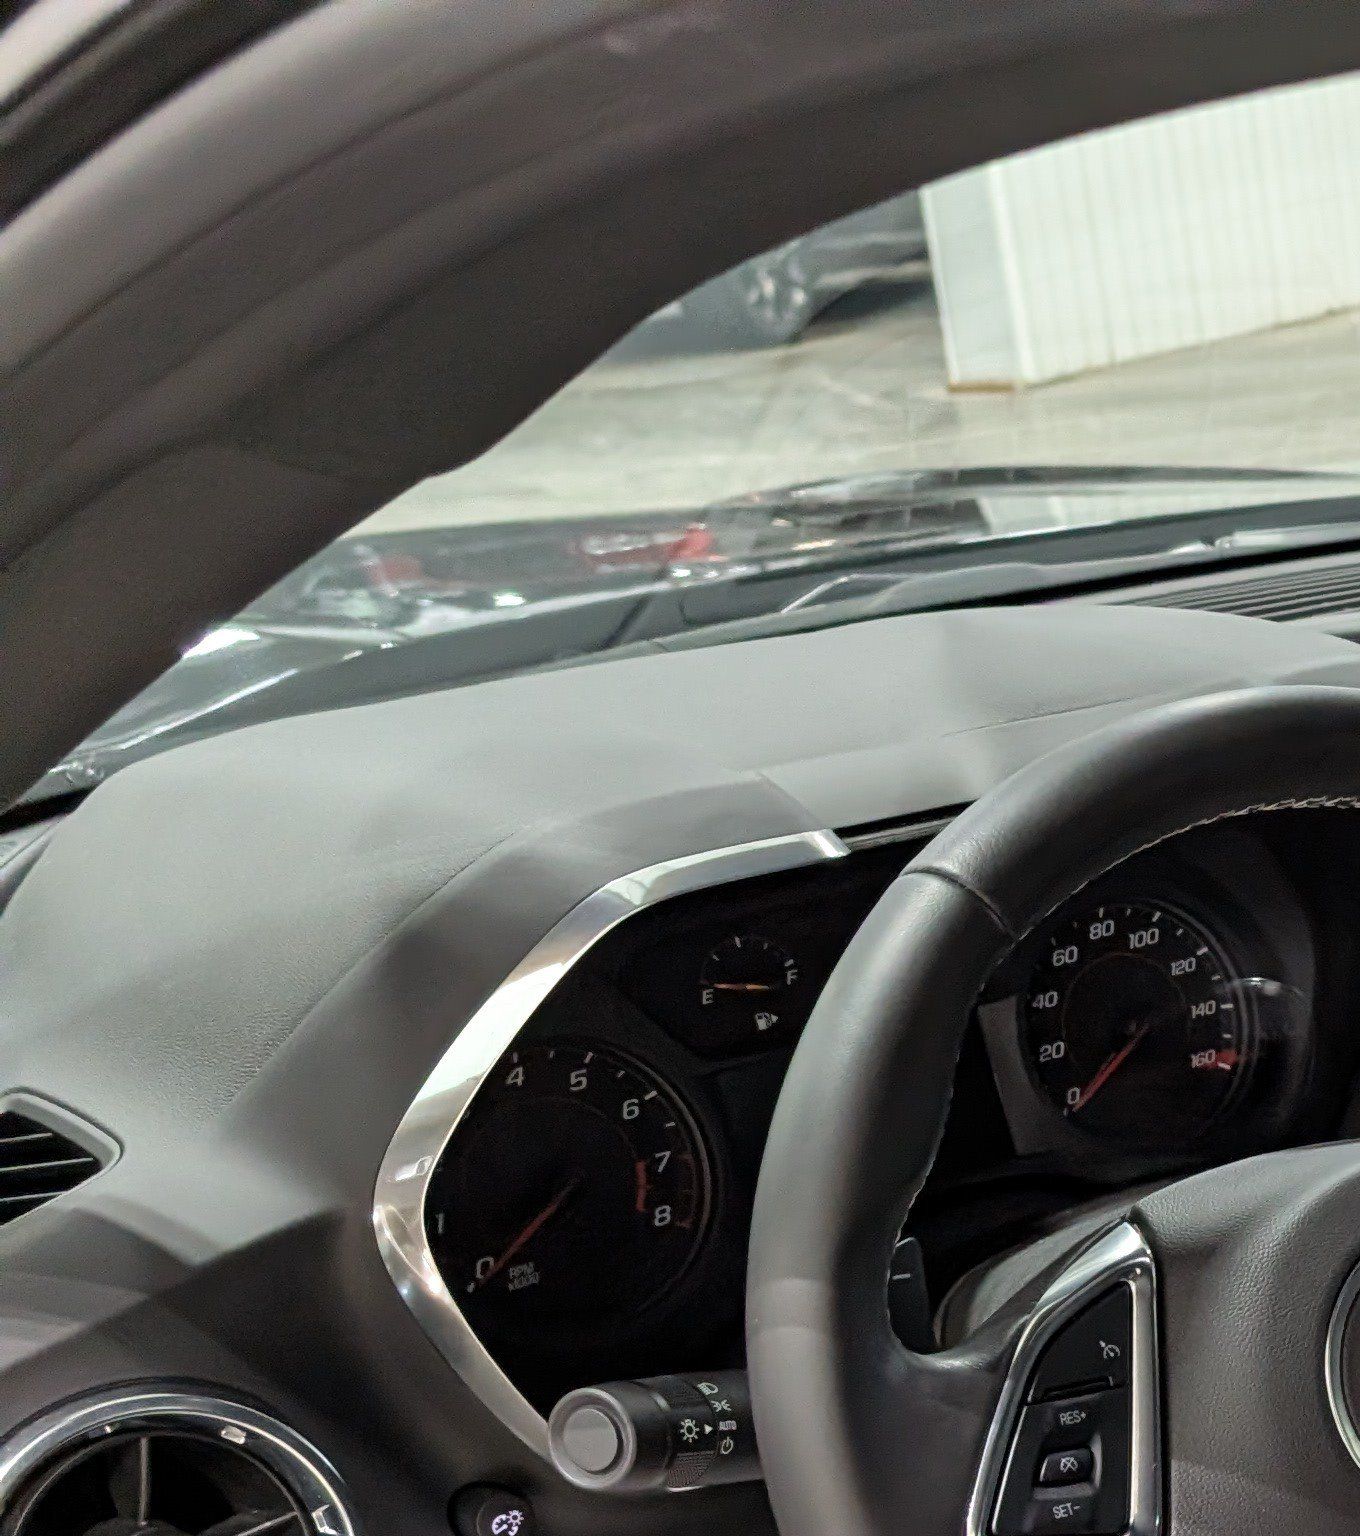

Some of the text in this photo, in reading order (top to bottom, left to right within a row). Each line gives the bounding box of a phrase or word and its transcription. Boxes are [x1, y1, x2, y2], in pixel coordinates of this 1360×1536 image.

[1089, 920, 1115, 940] 80
[1128, 928, 1160, 949] 100
[1052, 945, 1079, 967] 60
[1170, 957, 1196, 976] 120
[785, 969, 798, 985] F
[702, 989, 714, 1005] E
[1032, 991, 1059, 1010] 40
[1191, 1000, 1217, 1019] 140
[1039, 1041, 1065, 1062] 20
[1191, 1049, 1217, 1069] 160
[505, 1066, 525, 1087] 4
[569, 1069, 588, 1091] 5
[1067, 1087, 1081, 1105] 0
[622, 1098, 640, 1120] 6
[655, 1151, 672, 1173] 7
[654, 1204, 672, 1227] 8
[476, 1256, 495, 1280] 0
